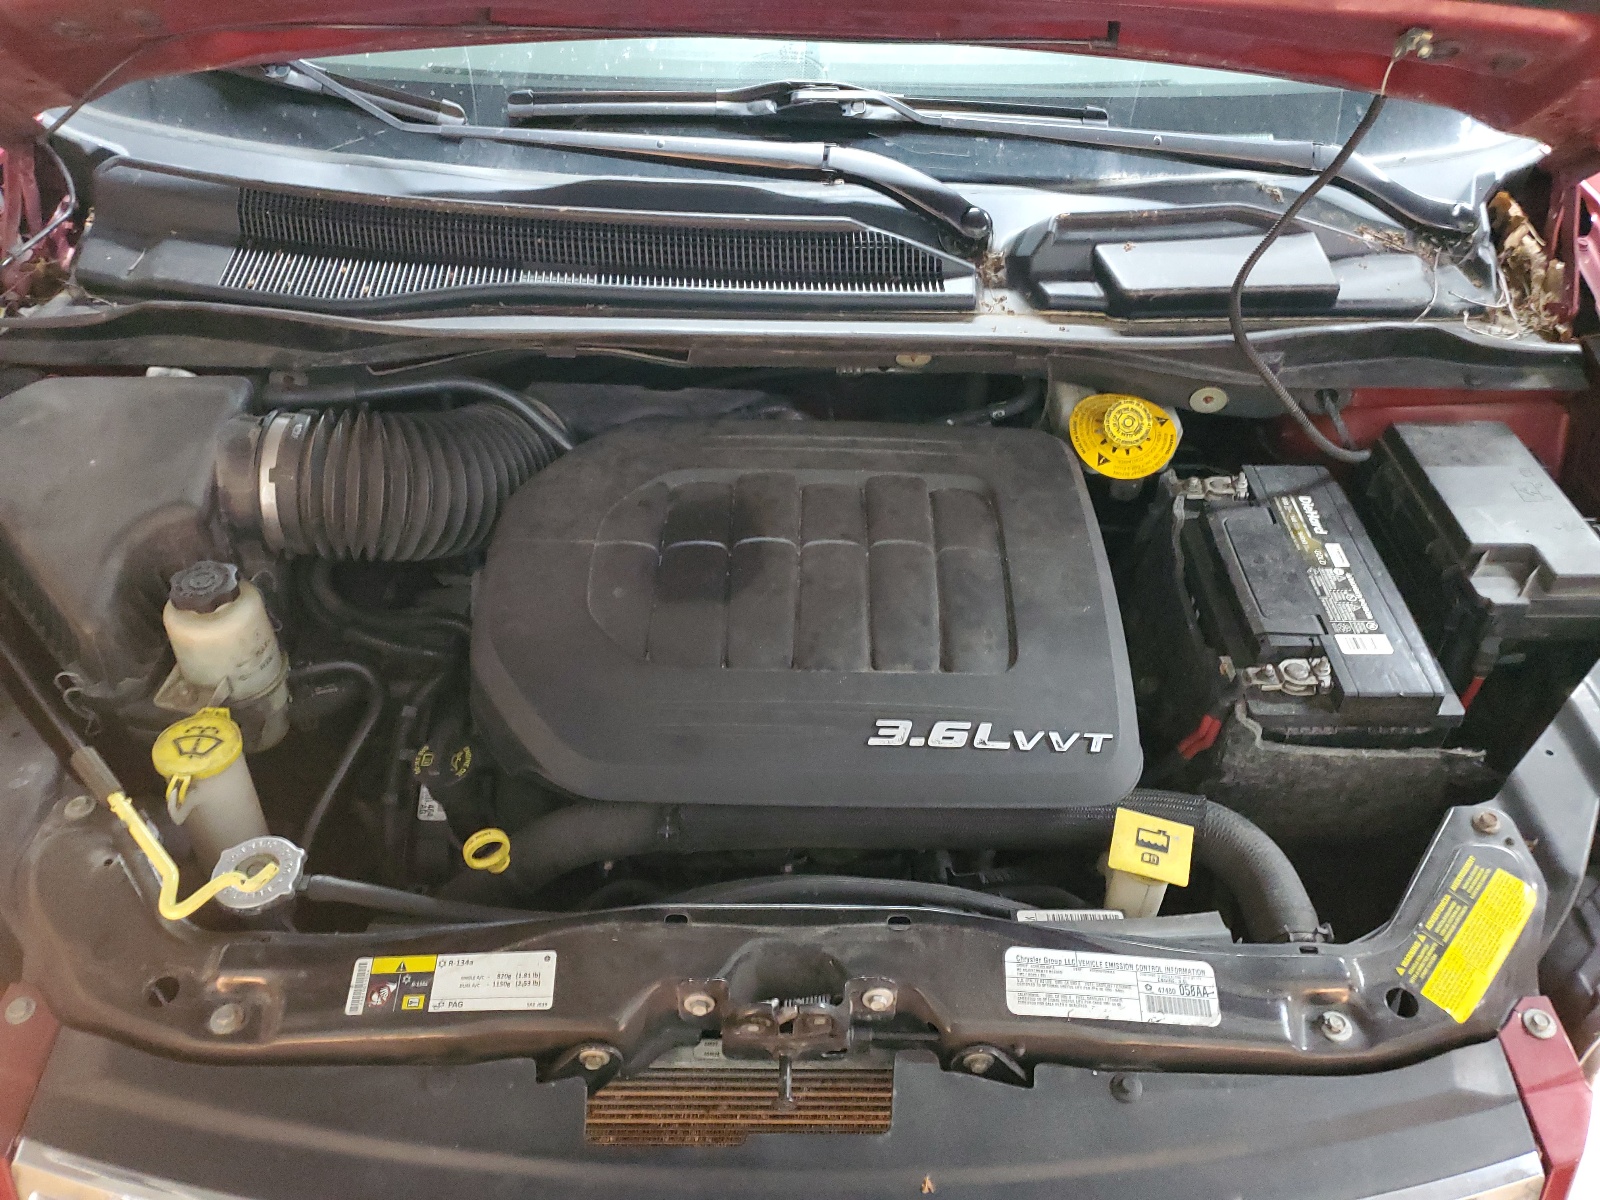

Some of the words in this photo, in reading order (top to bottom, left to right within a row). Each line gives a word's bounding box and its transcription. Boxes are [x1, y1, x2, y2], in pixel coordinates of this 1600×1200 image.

[1299, 495, 1329, 535] DieHard
[867, 719, 1011, 750] 3.6L
[1013, 730, 1114, 753] VVT
[448, 958, 474, 967] R-134a
[1016, 954, 1042, 964] Chrysler
[1043, 956, 1062, 965] Group
[1064, 958, 1076, 966] LLC
[1078, 959, 1103, 968] VEHICLE
[1104, 961, 1134, 971] EMISSION
[1136, 964, 1162, 973] CONTROL
[1164, 966, 1206, 976] INFORMATION
